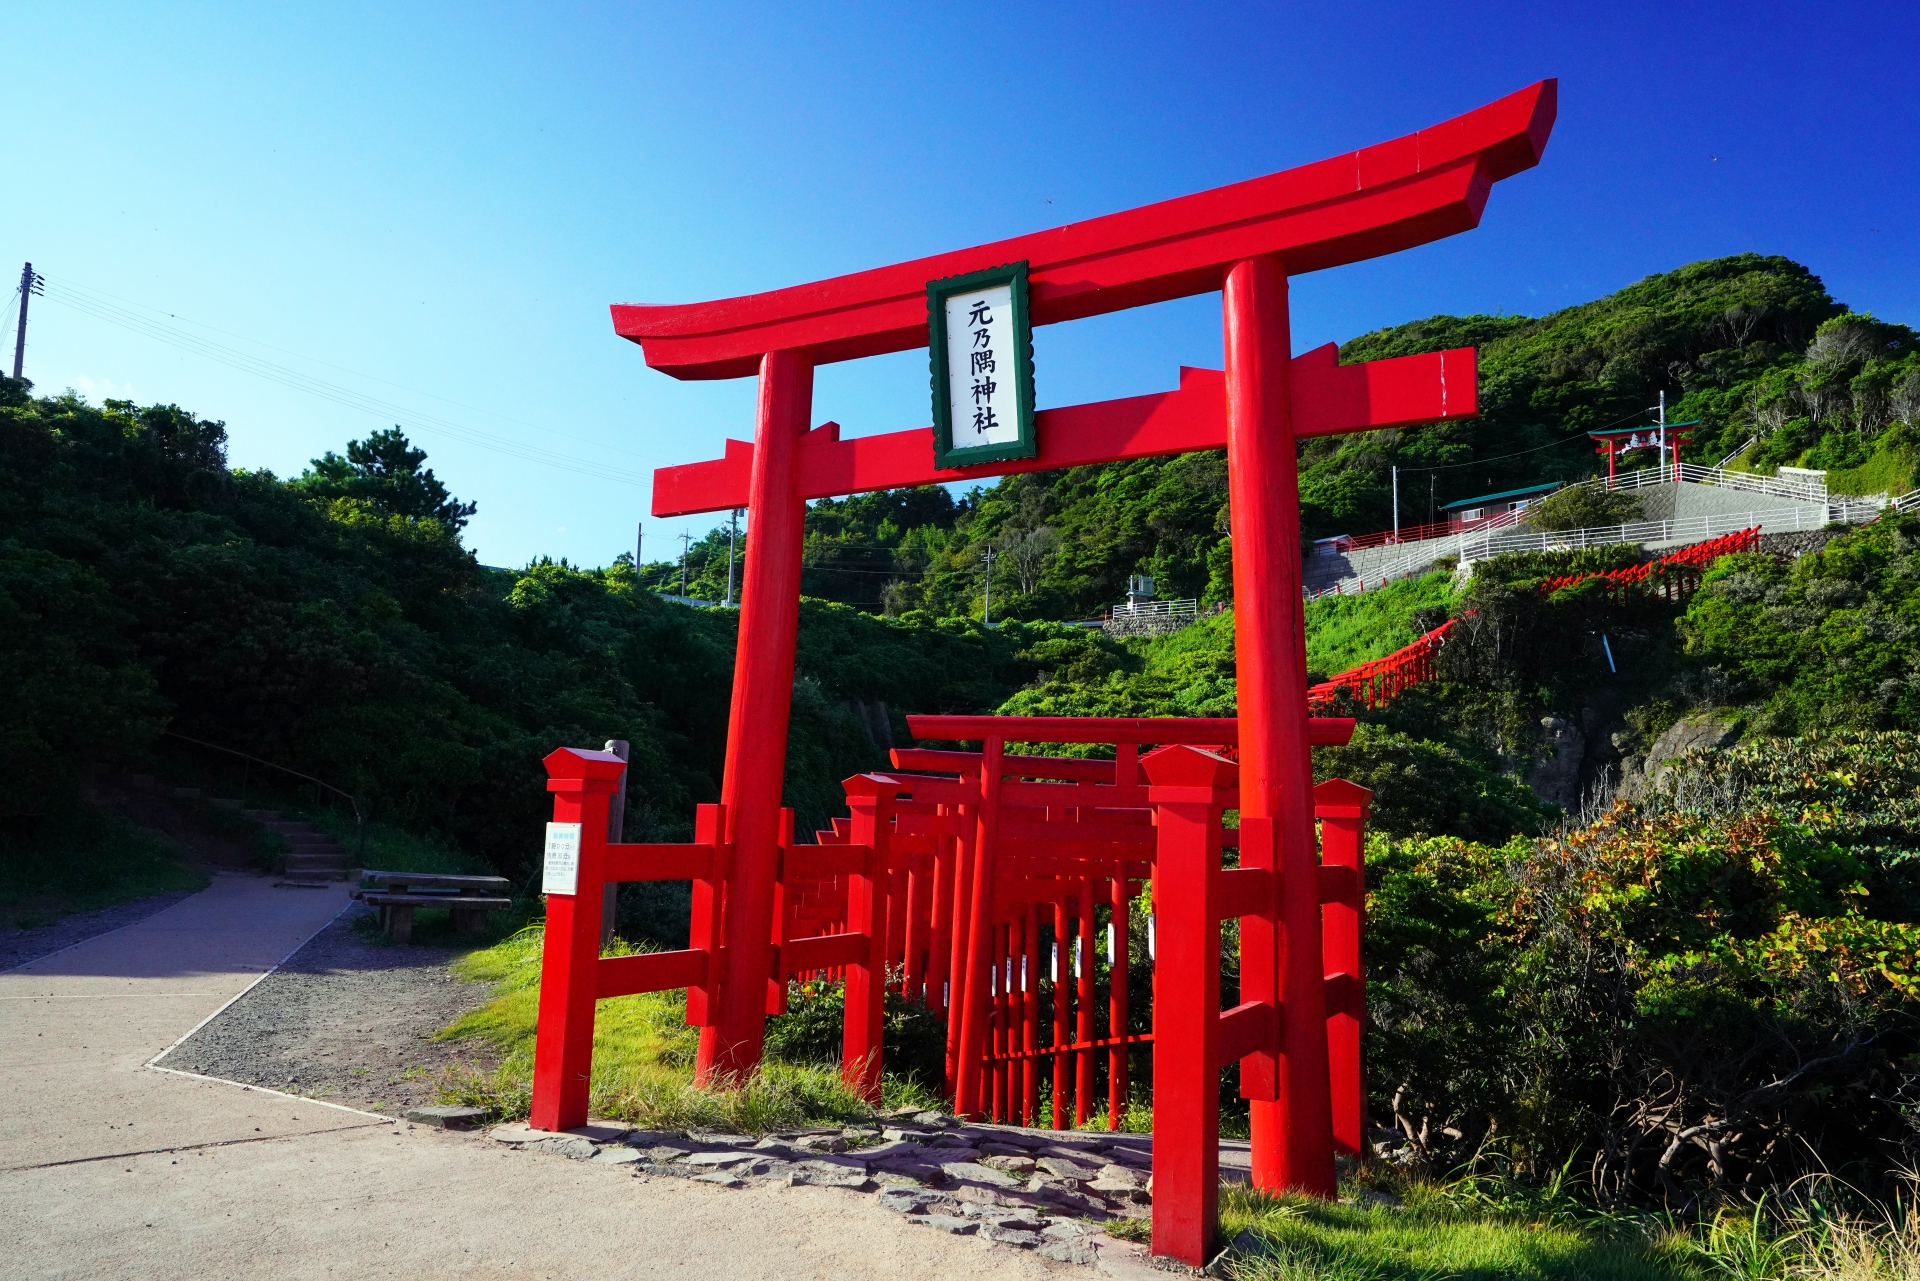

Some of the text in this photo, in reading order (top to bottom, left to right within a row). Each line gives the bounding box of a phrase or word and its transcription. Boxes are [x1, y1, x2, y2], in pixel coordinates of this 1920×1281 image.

[968, 300, 999, 434] 元乃隅神社
